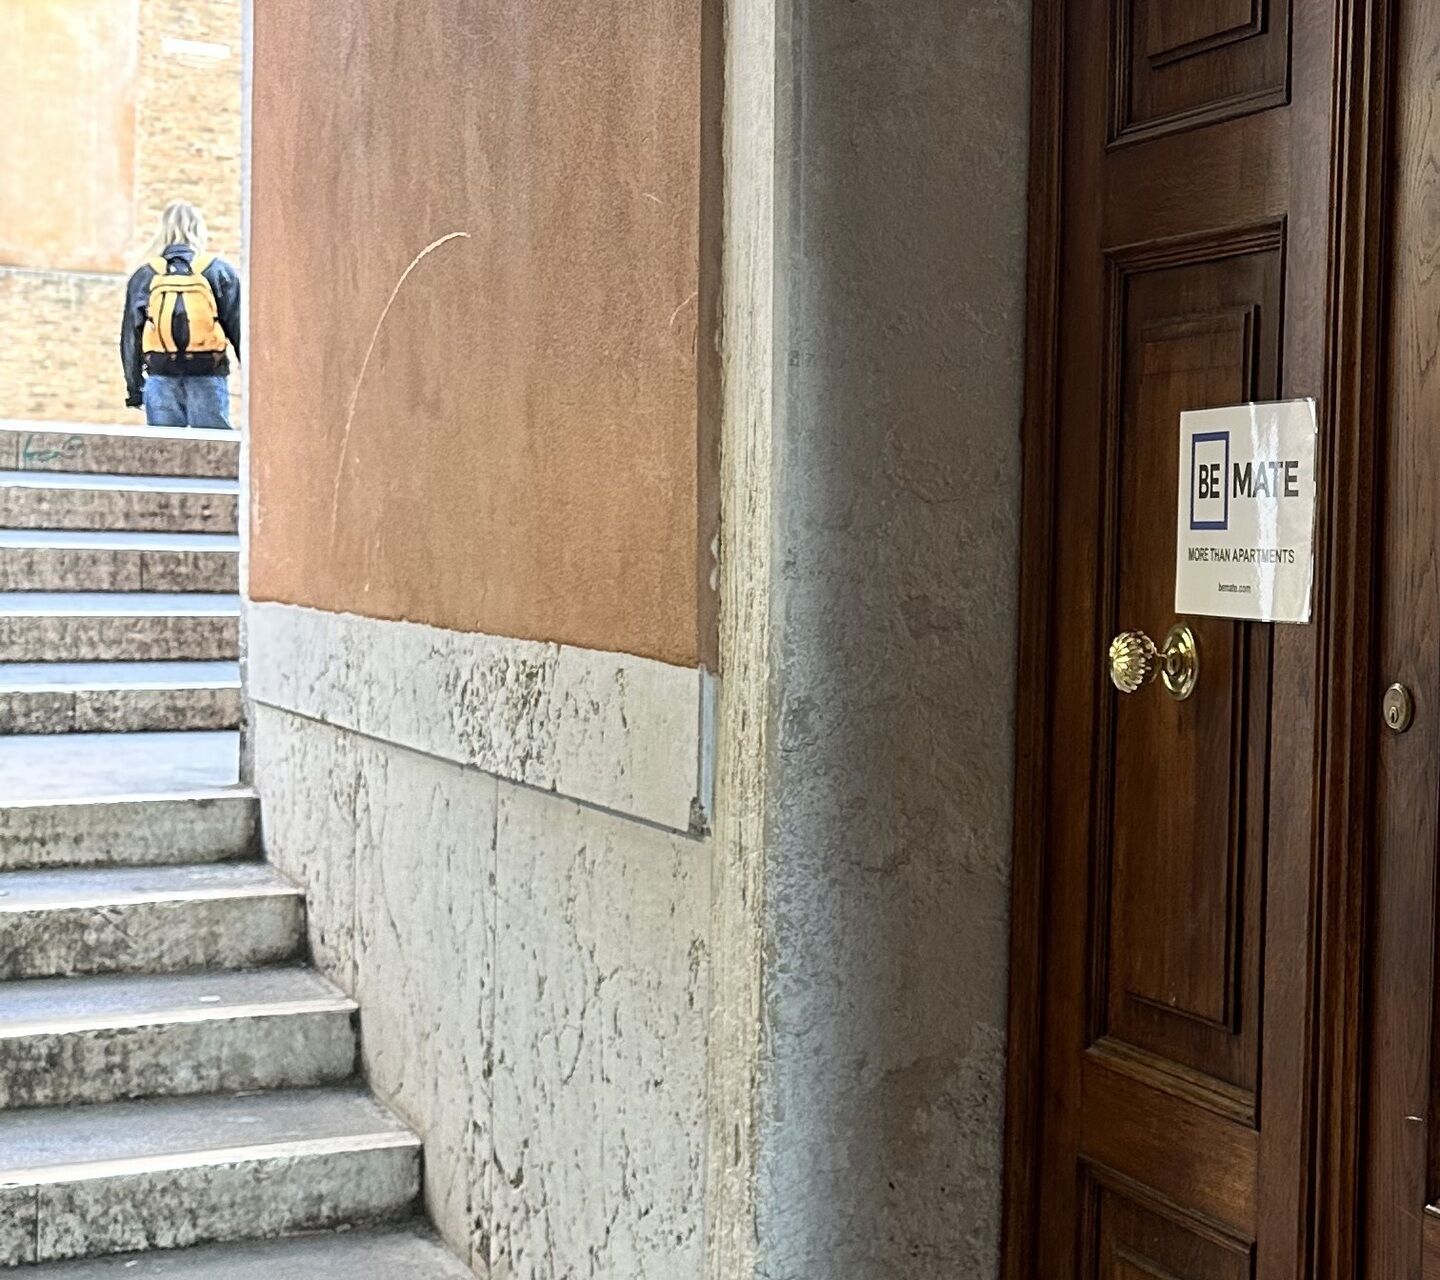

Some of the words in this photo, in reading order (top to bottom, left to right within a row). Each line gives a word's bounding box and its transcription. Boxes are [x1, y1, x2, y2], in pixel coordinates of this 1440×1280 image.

[1198, 463, 1221, 499] BE
[1232, 461, 1299, 499] MATE
[1188, 547, 1209, 562] MORE
[1209, 547, 1231, 562] THAN
[1232, 548, 1296, 564] APARTMENTS
[1218, 581, 1252, 594] bemate.com
